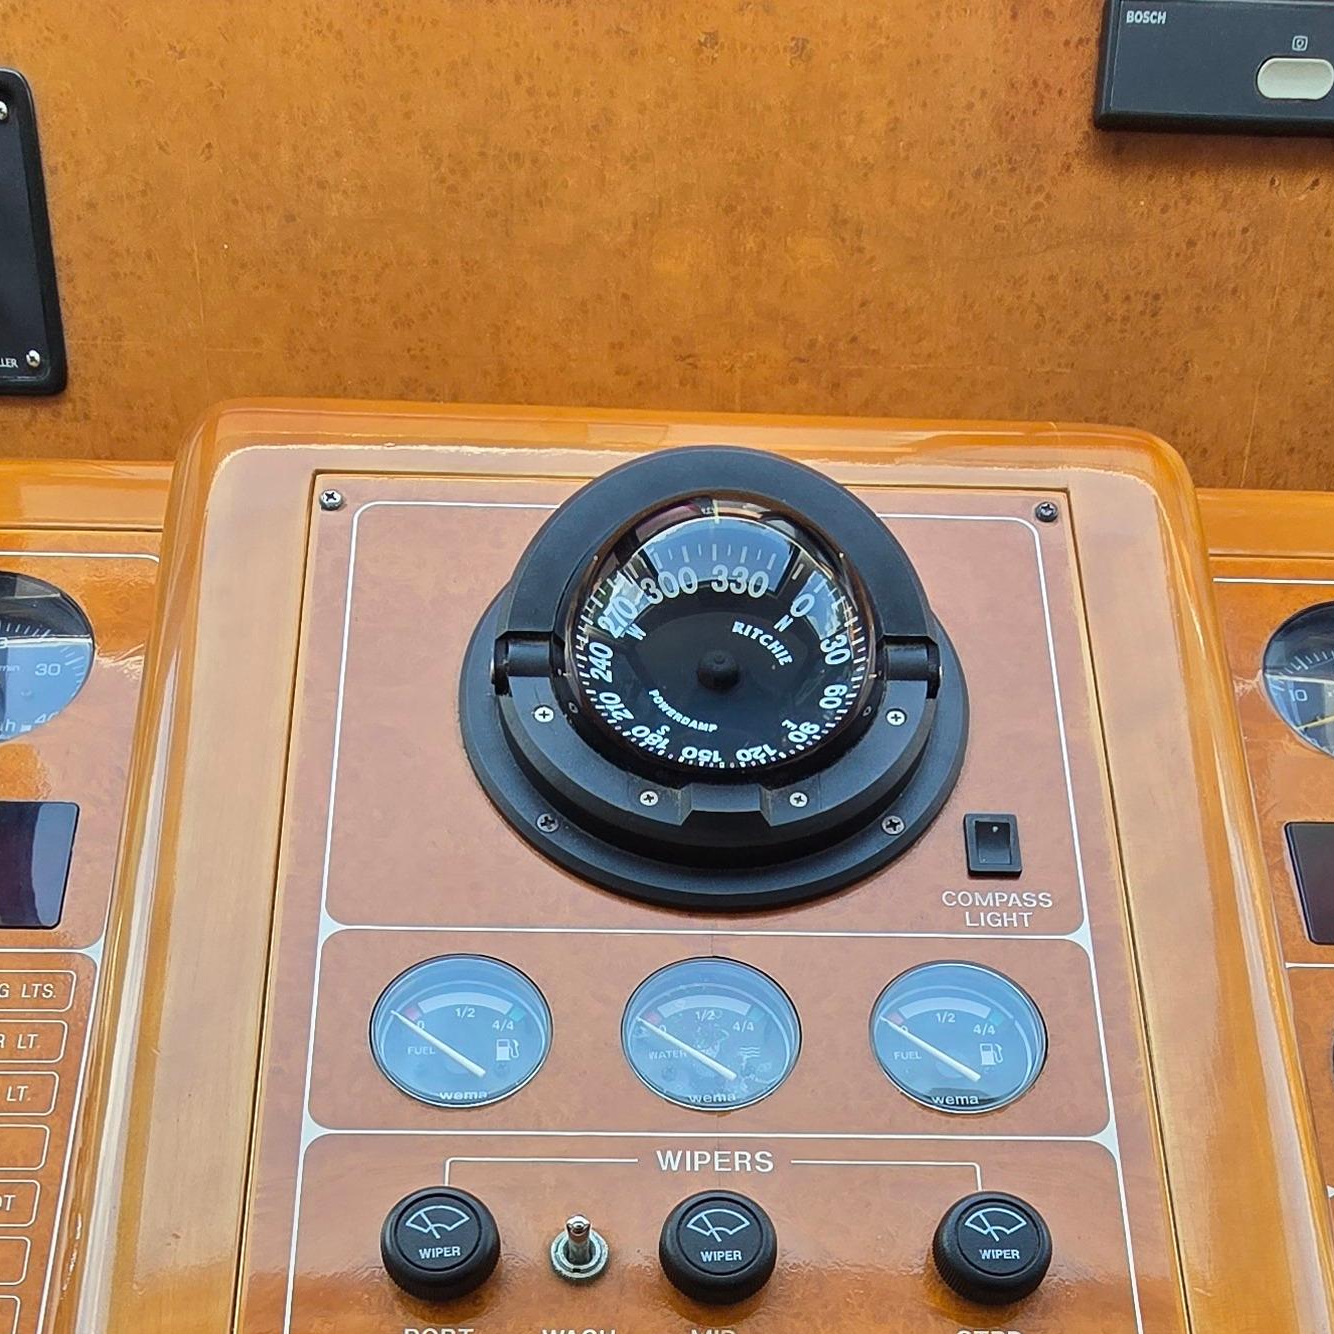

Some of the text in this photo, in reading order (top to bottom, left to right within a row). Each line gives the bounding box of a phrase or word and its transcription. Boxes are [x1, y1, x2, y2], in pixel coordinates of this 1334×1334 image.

[1126, 11, 1167, 25] BOSCH
[640, 566, 698, 605] 300
[710, 564, 769, 599] 330
[597, 600, 637, 638] 270
[773, 616, 793, 633] N
[731, 621, 793, 666] RITCHIE
[820, 634, 851, 665] 30
[588, 641, 613, 683] 240
[34, 664, 61, 677] 30
[819, 684, 848, 710] 60
[1288, 690, 1308, 702] 10
[599, 691, 634, 721] 210
[648, 688, 718, 733] POWERDAMP
[631, 725, 670, 750] 180
[788, 720, 820, 743] 90
[681, 746, 722, 763] 150
[735, 744, 777, 763] 120
[942, 890, 1053, 908] COMPASS
[965, 912, 1033, 927] LIGHT
[21, 984, 56, 999] LTS.
[455, 1008, 475, 1018] 1/2
[935, 1012, 956, 1023] 1/2
[492, 1020, 514, 1031] 4/4
[732, 1022, 754, 1032] 4/4
[973, 1024, 995, 1035] 4/4
[17, 1034, 41, 1049] LT.
[407, 1047, 435, 1055] FUEL
[894, 1051, 921, 1060] FUEL
[7, 1086, 31, 1101] LT.
[439, 1091, 487, 1100] wema
[689, 1092, 736, 1103] wema
[931, 1095, 979, 1105] wema
[657, 1150, 774, 1173] WIPERS
[419, 1246, 461, 1259] WIPER
[700, 1250, 742, 1262] WIPER
[979, 1249, 1020, 1260] WIPER
